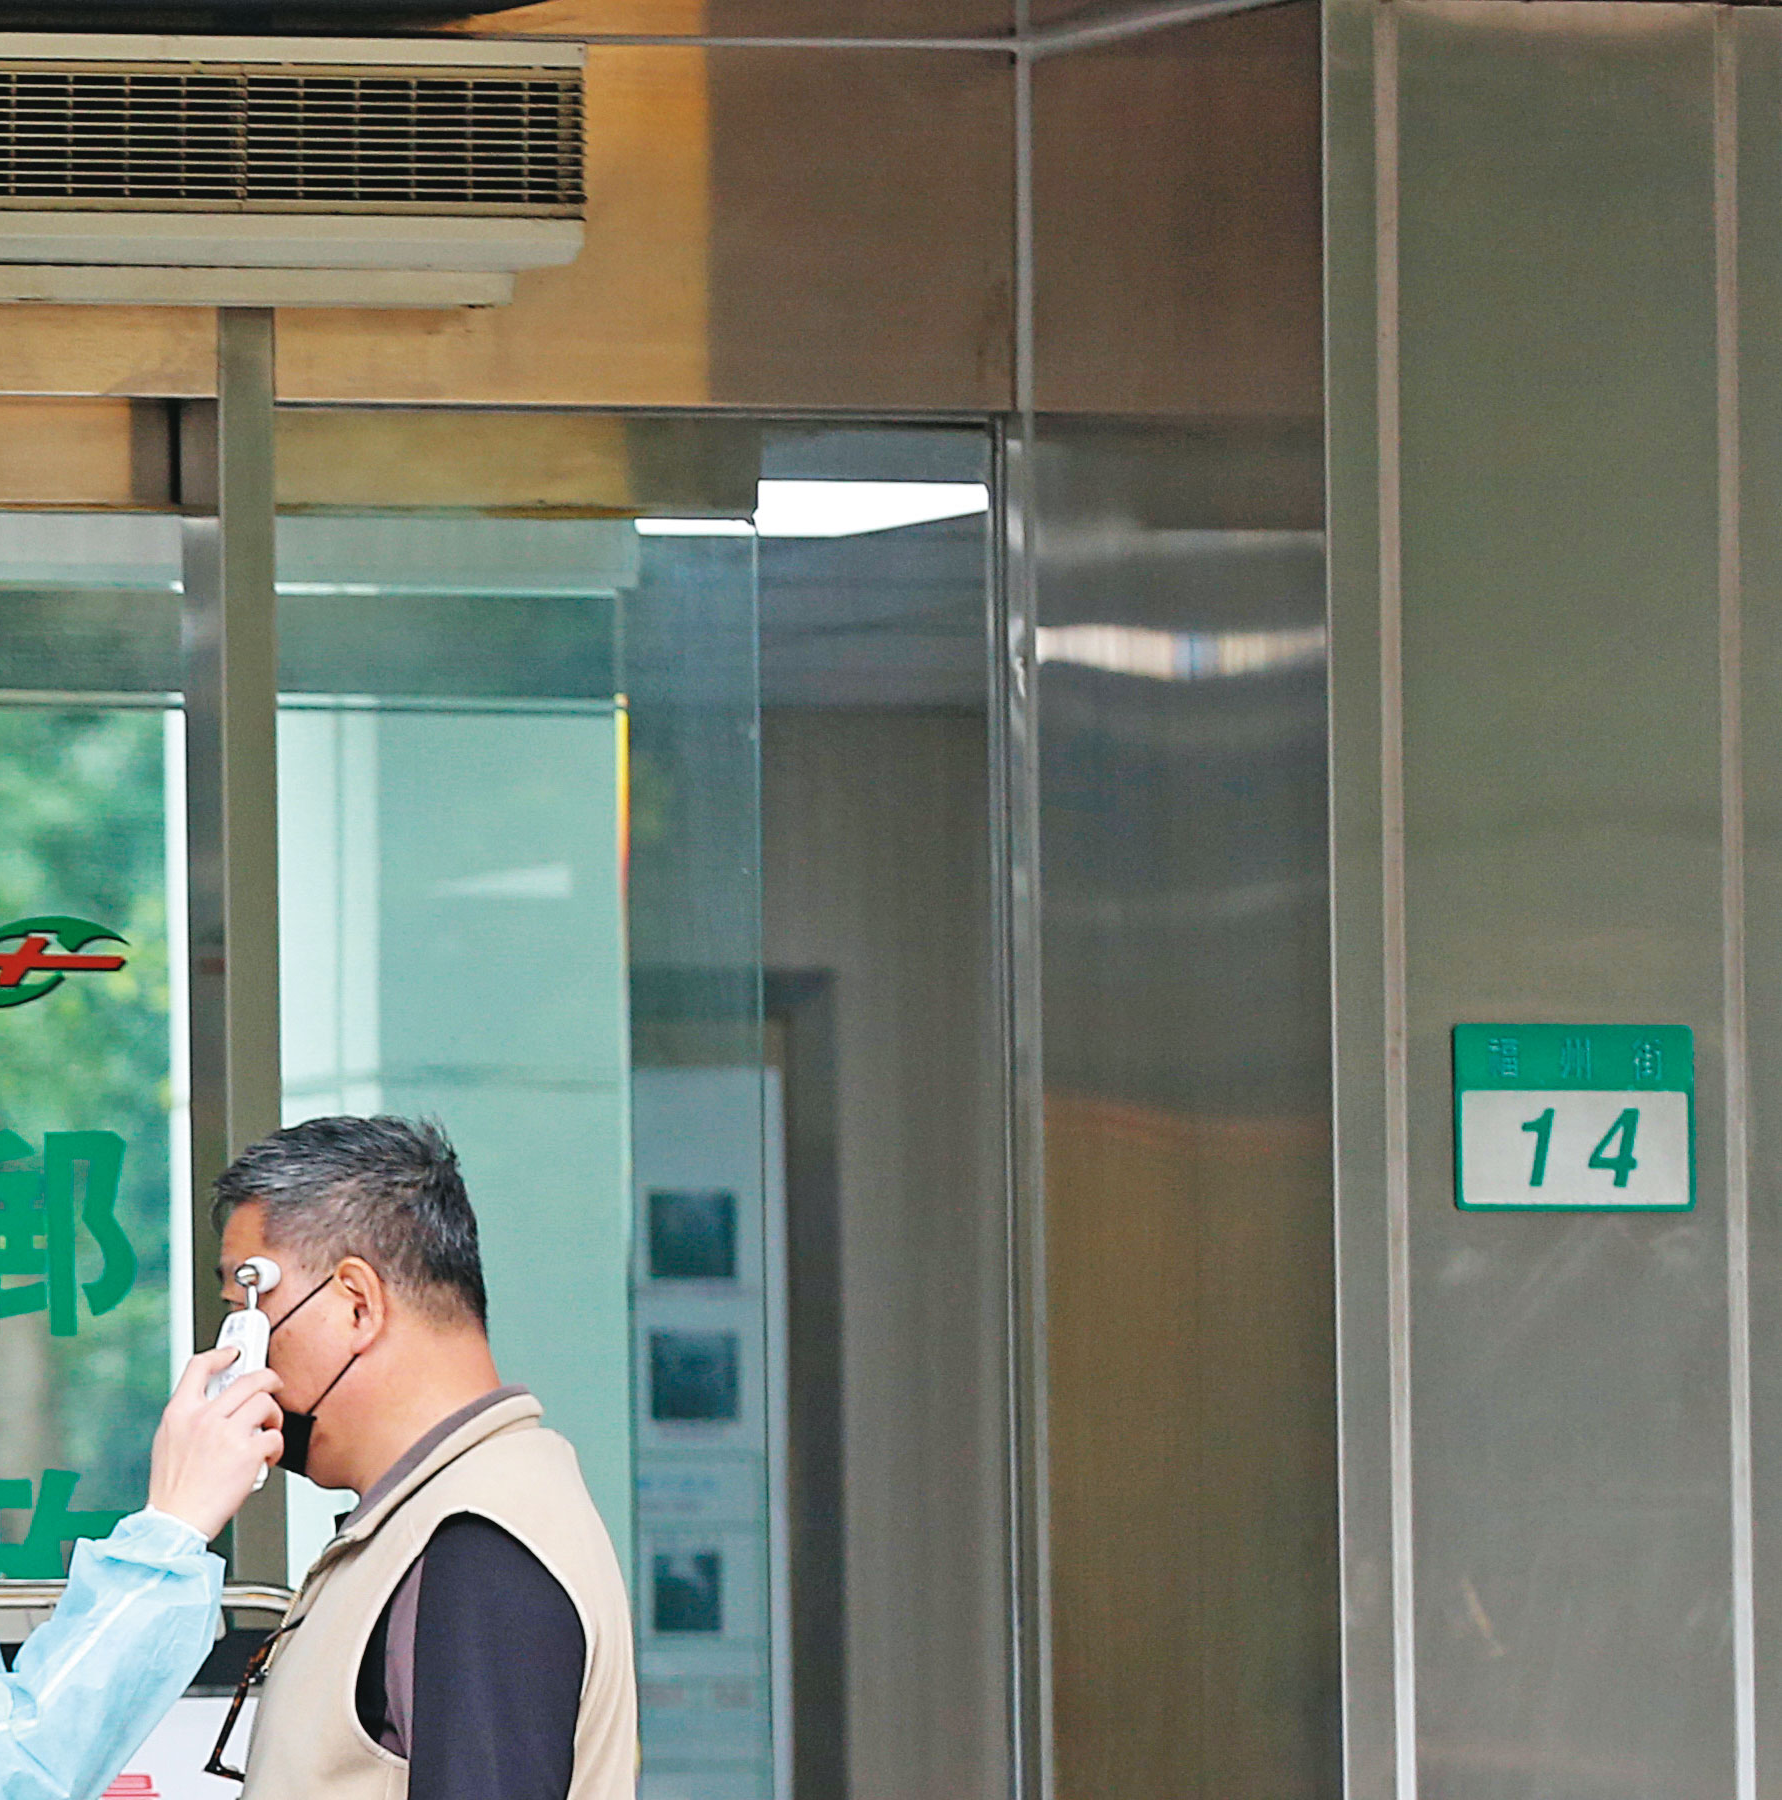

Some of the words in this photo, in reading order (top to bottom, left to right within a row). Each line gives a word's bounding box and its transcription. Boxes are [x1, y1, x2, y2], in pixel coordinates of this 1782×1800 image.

[1488, 1037, 1663, 1081] 福州街
[1521, 1107, 1640, 1188] 14
